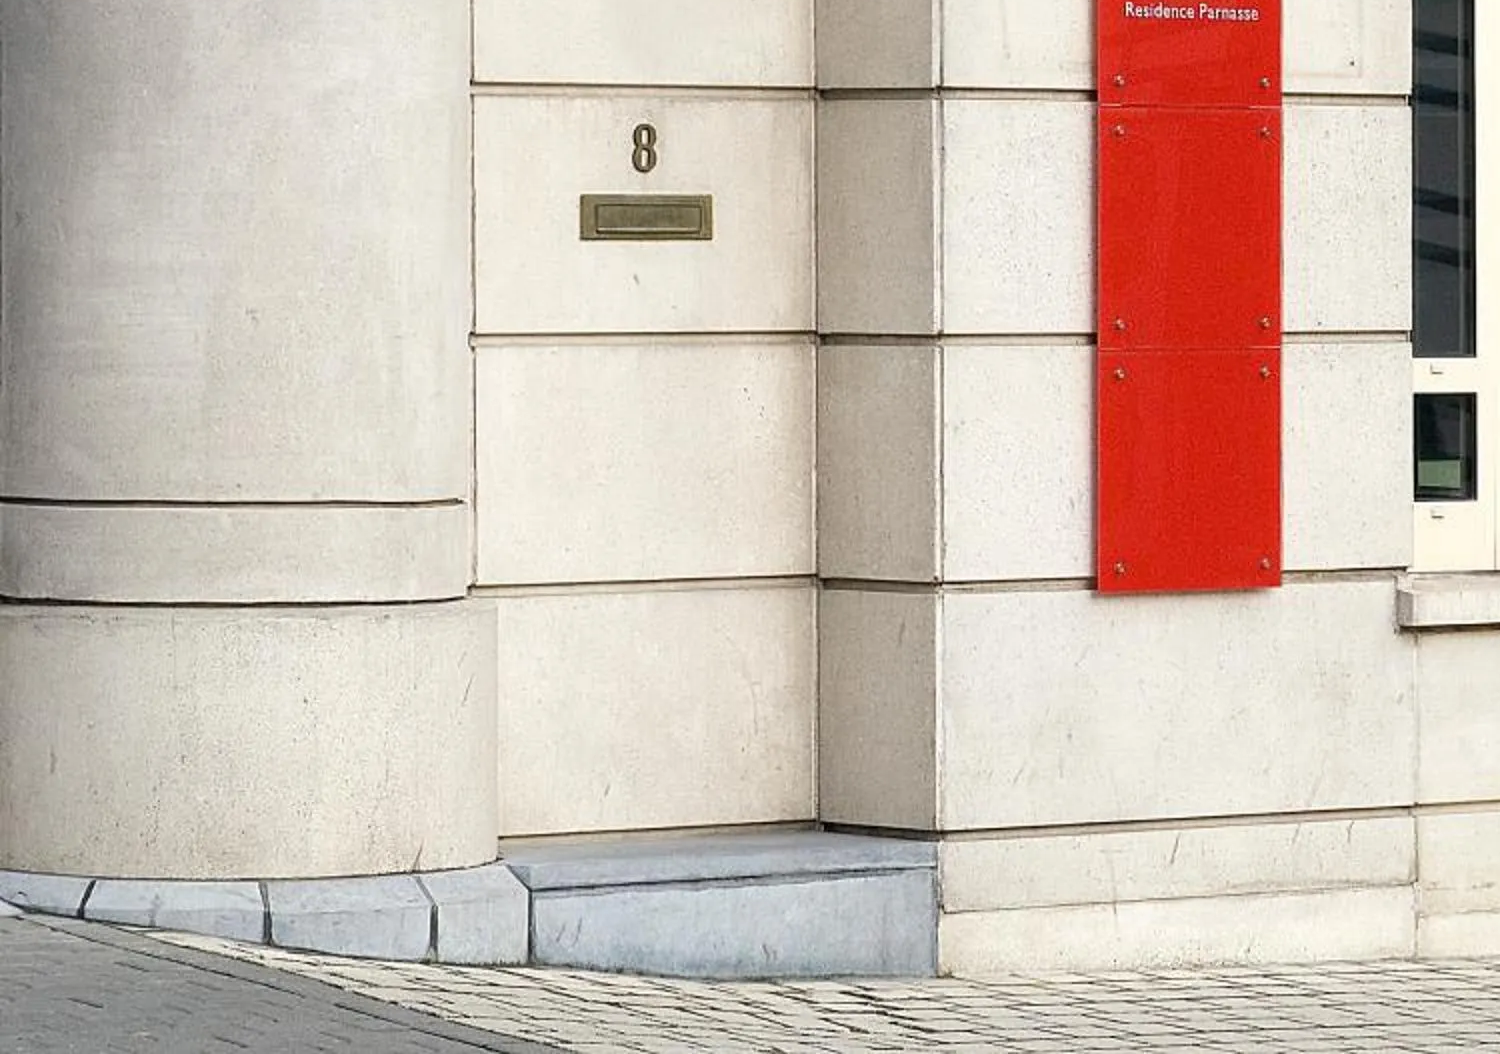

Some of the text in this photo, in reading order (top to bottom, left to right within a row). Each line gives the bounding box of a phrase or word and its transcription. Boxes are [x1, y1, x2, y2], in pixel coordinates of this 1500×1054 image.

[1125, 1, 1260, 21] Residence Parnasse
[632, 123, 657, 173] 8
